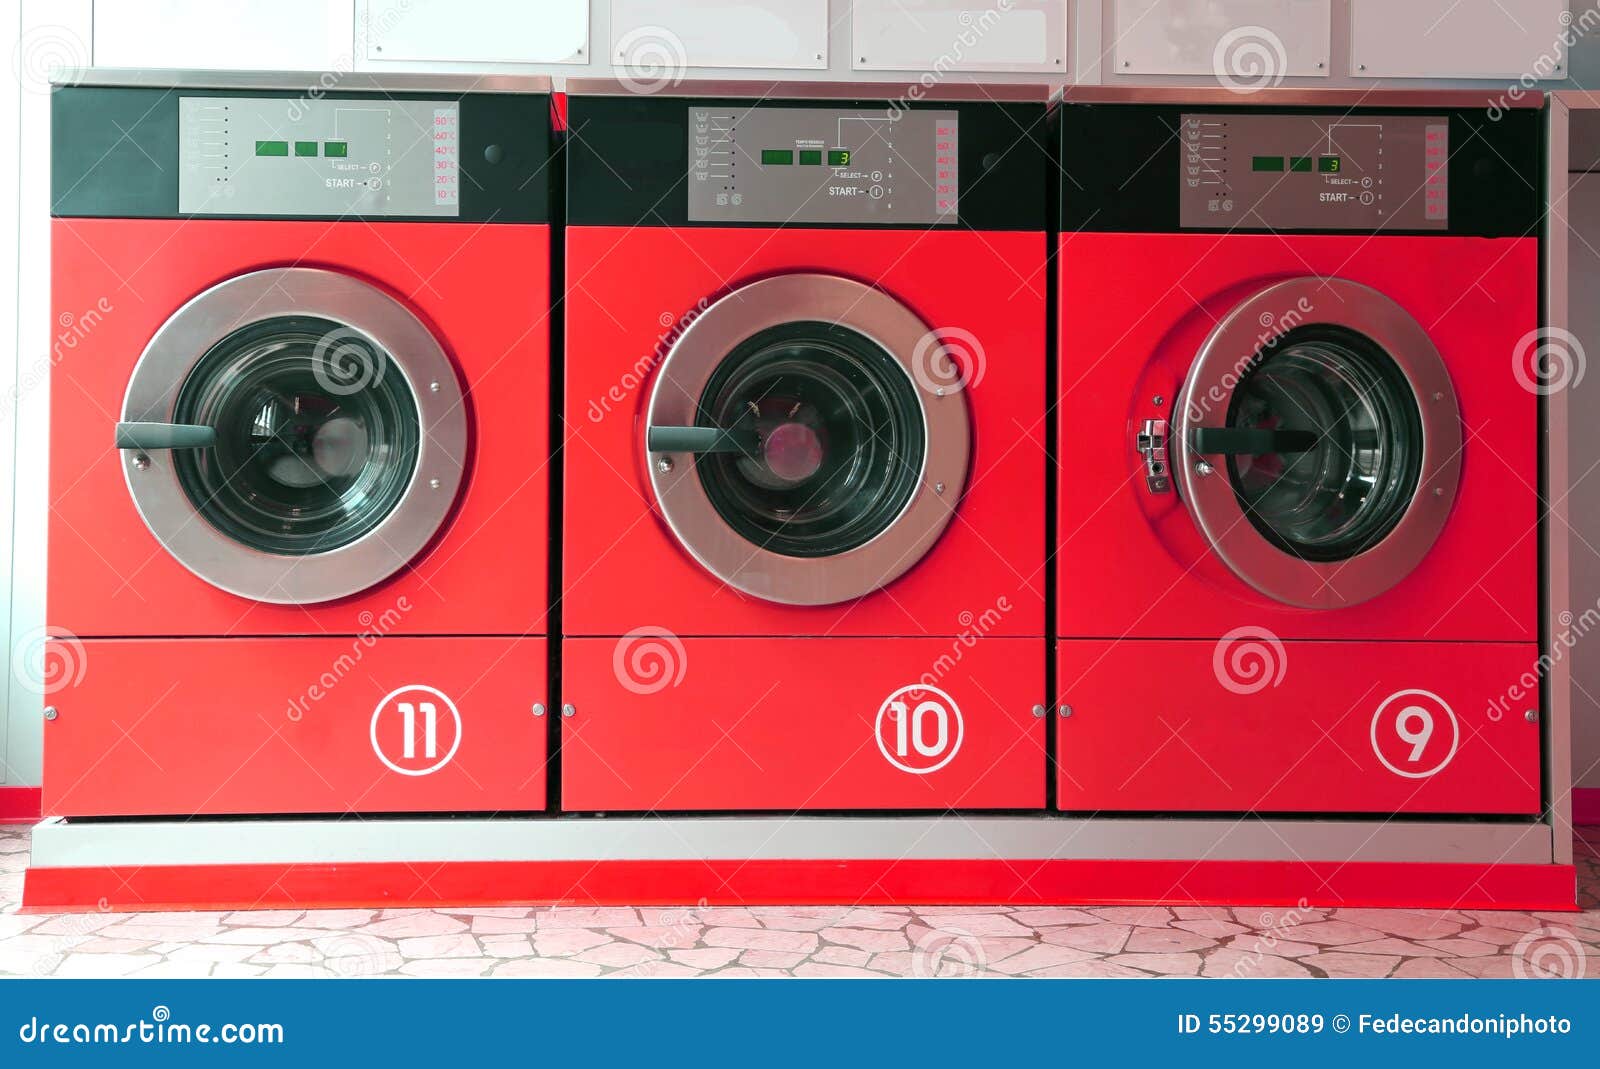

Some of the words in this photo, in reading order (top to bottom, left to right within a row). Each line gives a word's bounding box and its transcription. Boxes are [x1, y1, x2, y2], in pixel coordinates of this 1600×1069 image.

[840, 152, 849, 164] 3
[1331, 160, 1339, 171] 3
[325, 178, 355, 188] START
[828, 186, 858, 196] START
[1319, 192, 1348, 202] START
[398, 702, 437, 758] 11
[890, 701, 948, 757] 10
[1395, 705, 1434, 762] 9
